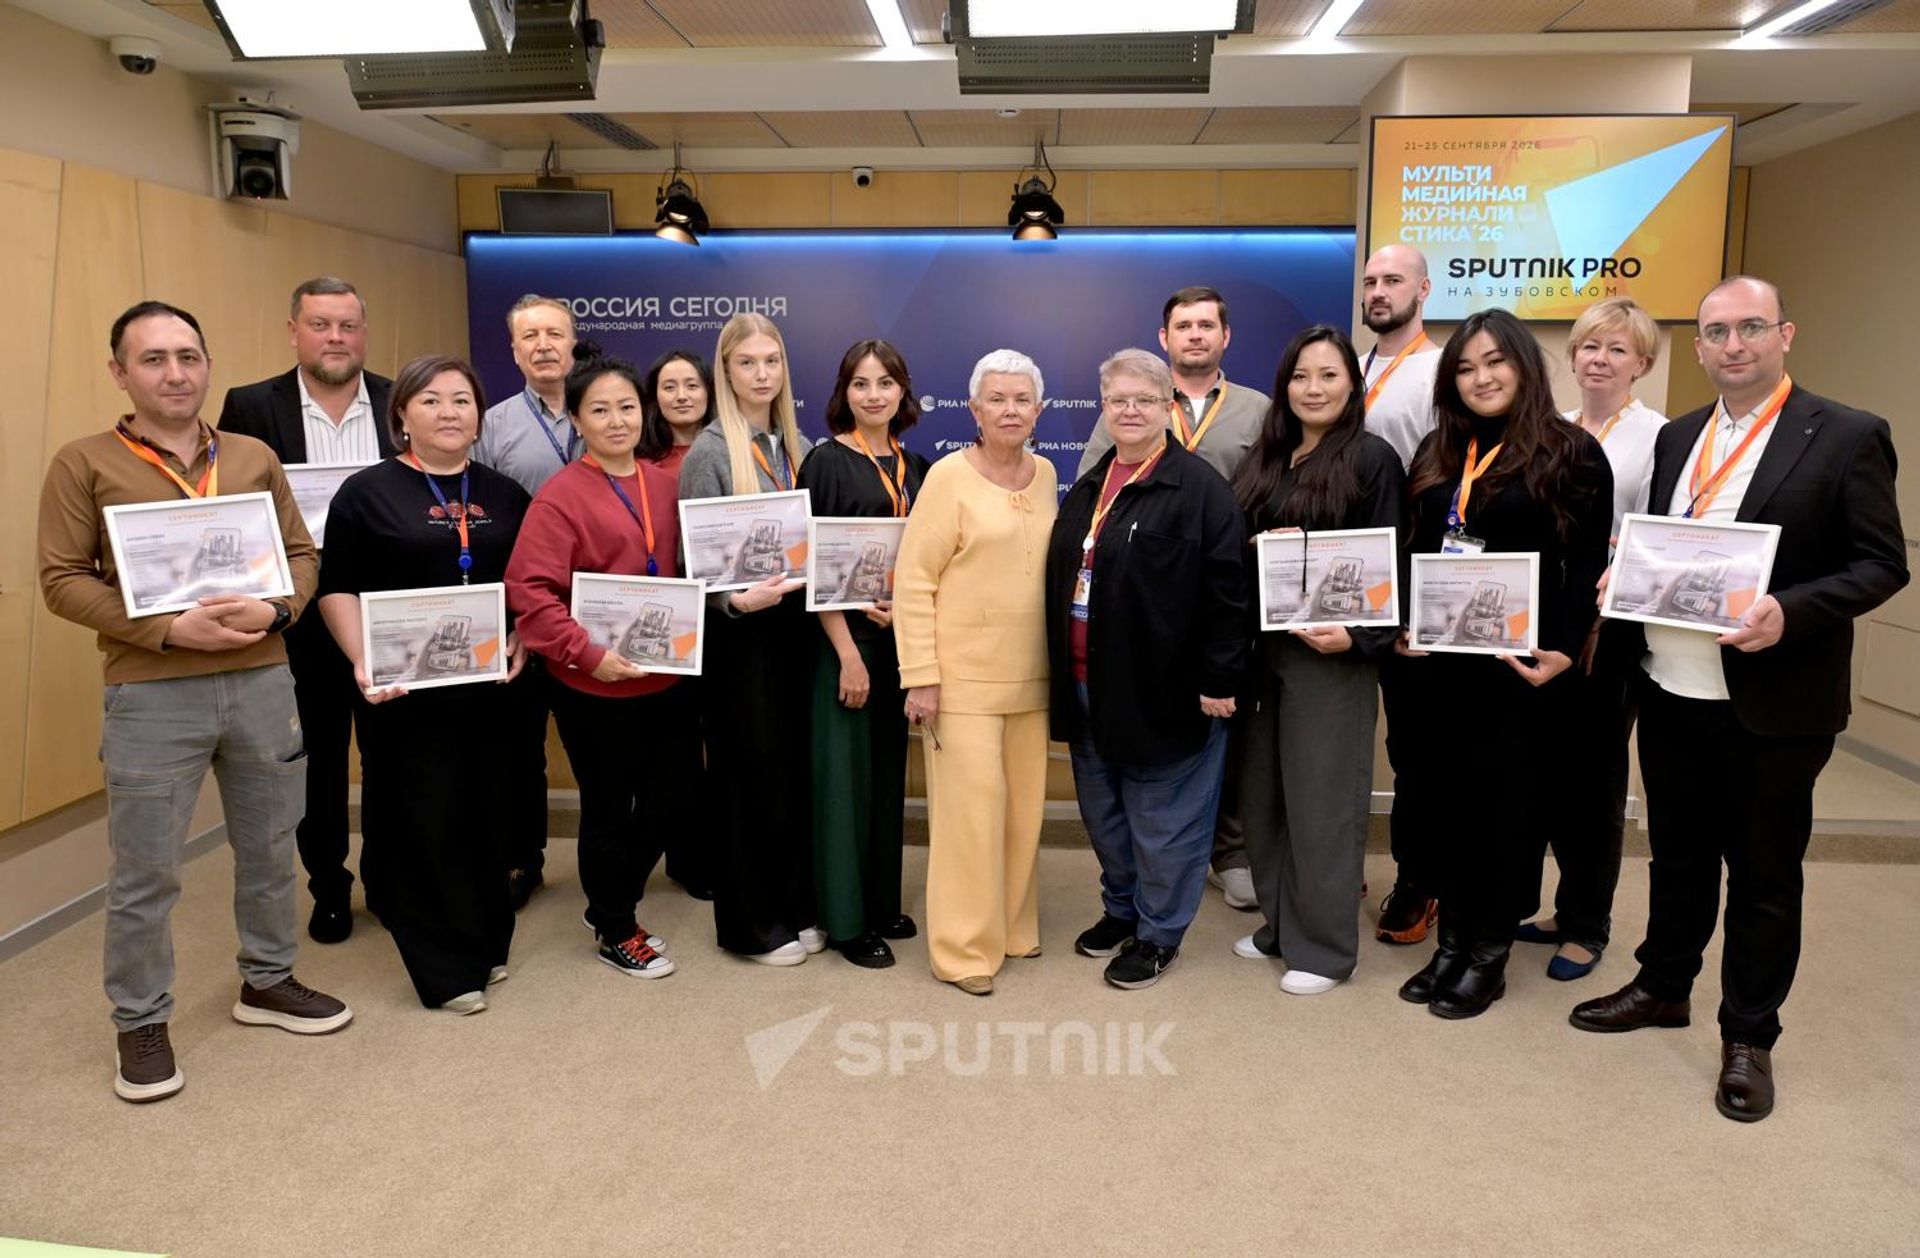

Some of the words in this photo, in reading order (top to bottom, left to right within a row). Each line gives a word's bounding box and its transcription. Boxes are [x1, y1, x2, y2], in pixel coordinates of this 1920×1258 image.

[1443, 140, 1507, 150] СЕНТЯБРЯ
[1402, 165, 1493, 182] МУЛЬТИ
[1401, 181, 1528, 204] МЕДИЙНАЯ
[1400, 205, 1515, 222] ЖУРНАЛИ
[1448, 257, 1576, 279] SPUTNIK
[1582, 257, 1642, 279] PRO
[1447, 286, 1473, 297] НА
[1486, 286, 1618, 297] ЗУБОВСКОМ
[669, 297, 788, 317] СЕГОДНЯ
[937, 399, 959, 408] РИА
[1052, 399, 1097, 409] SPUTNIK
[1038, 442, 1060, 450] РИА
